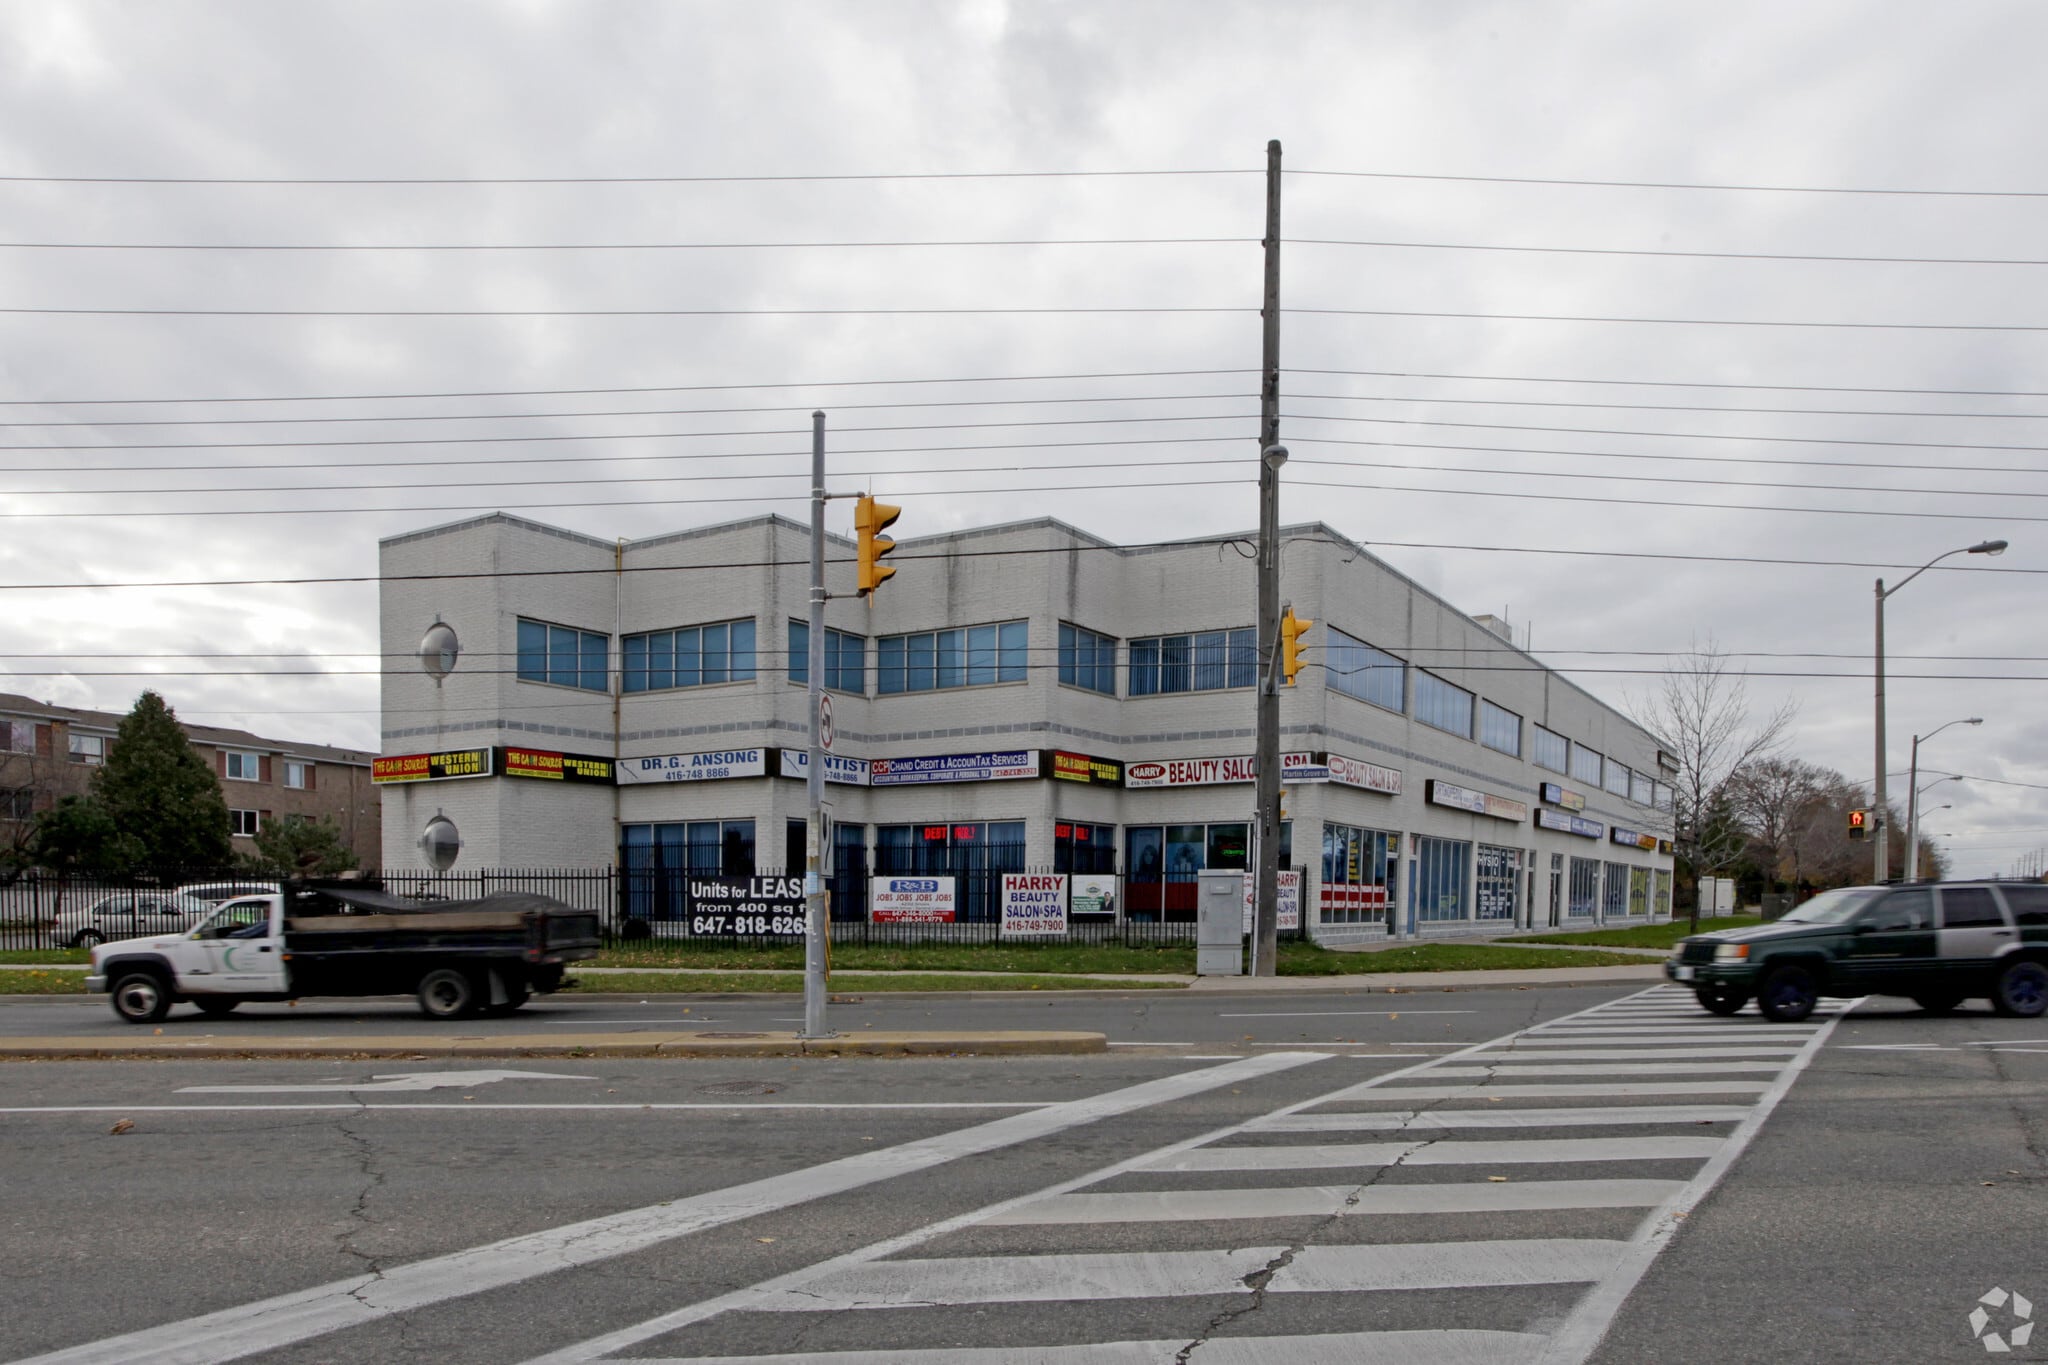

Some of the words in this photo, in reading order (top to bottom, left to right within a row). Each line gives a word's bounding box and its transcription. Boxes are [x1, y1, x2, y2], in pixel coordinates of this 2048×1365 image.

[430, 752, 480, 766] WESTERN
[563, 759, 608, 769] WESTERN
[692, 750, 758, 766] ANSONG
[799, 753, 868, 773] DNTIST
[914, 759, 940, 770] CREDIT
[940, 759, 946, 769] &
[991, 754, 1027, 765] SERVICES
[444, 763, 480, 775] UNION
[576, 768, 608, 777] UNION
[1133, 767, 1161, 777] HARRY
[1169, 760, 1218, 783] BEAUTY
[1222, 758, 1256, 780] SALO
[1283, 768, 1302, 778] Martin
[1303, 768, 1320, 777] Grove
[1345, 761, 1368, 784] BEAUTY
[691, 881, 729, 898] Units
[731, 886, 747, 898] for
[1006, 876, 1064, 890] HARRY
[876, 894, 893, 902] JOBS
[896, 894, 913, 902] JOBS
[915, 894, 932, 902] JOBS
[935, 894, 952, 902] JOBS
[1011, 892, 1059, 902] BEAUTY
[696, 903, 732, 912] from
[736, 903, 767, 913] 400
[772, 904, 797, 915] sq
[1006, 904, 1039, 918] SALON
[1044, 904, 1062, 918] SPA
[1006, 920, 1064, 931] 416-749-7900
